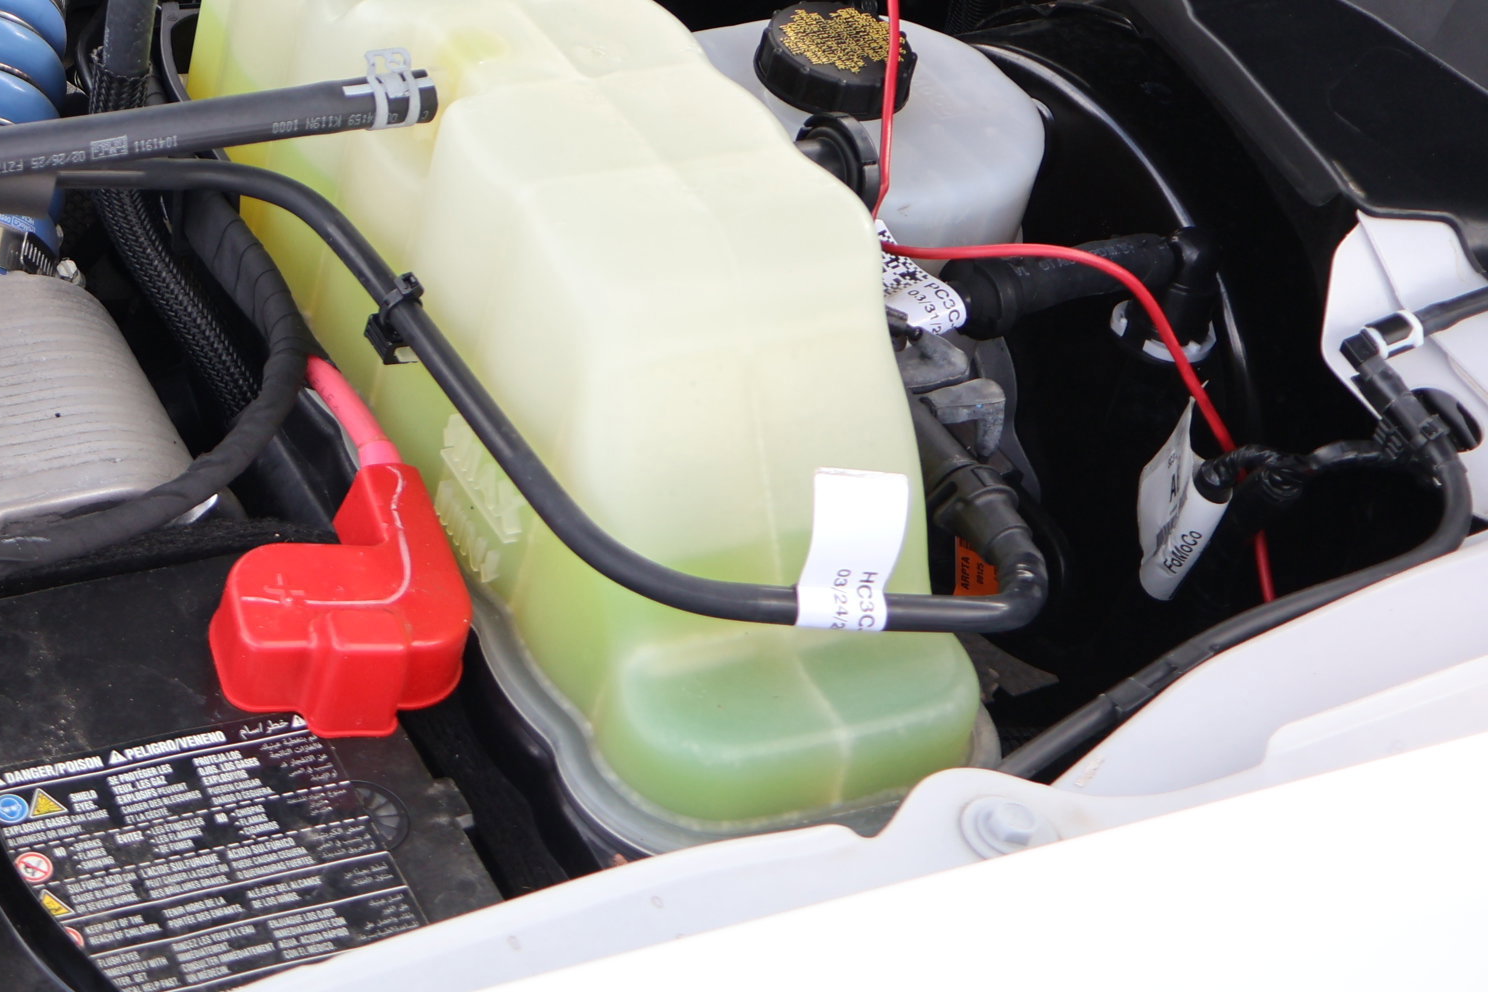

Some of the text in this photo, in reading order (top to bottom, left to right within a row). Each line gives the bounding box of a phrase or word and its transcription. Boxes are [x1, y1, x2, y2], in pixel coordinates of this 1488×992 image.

[924, 283, 960, 327] PC3C
[1164, 530, 1202, 575] FoMoCo
[857, 571, 879, 631] HC3C
[124, 731, 227, 760] PELIGRO/VENENO
[193, 750, 242, 767] PROTEJA LOS
[221, 762, 236, 772] LOS
[236, 757, 260, 769] GASES
[4, 756, 104, 784] DANGER/POISON
[107, 776, 118, 785] SE
[157, 764, 173, 775] LES
[135, 779, 150, 789] LES
[150, 776, 168, 787] GAZ
[202, 770, 249, 786] EXPLOSIVOS
[236, 778, 262, 790] CAUSAR
[69, 790, 98, 801] SHIELD
[115, 782, 188, 805] EXPLOSIFS PEUVENT
[121, 790, 202, 815] CAUSER DES BLESSURES
[3, 809, 109, 837] EXPLOSIVE GASES CAN CAUSE
[240, 814, 269, 826] FLAMAS
[151, 825, 164, 835] LES
[7, 831, 46, 846] BLINDNESS
[75, 838, 103, 850] SPARKS
[155, 834, 168, 844] LES
[53, 847, 67, 857] NO
[79, 848, 107, 860] FLAMES
